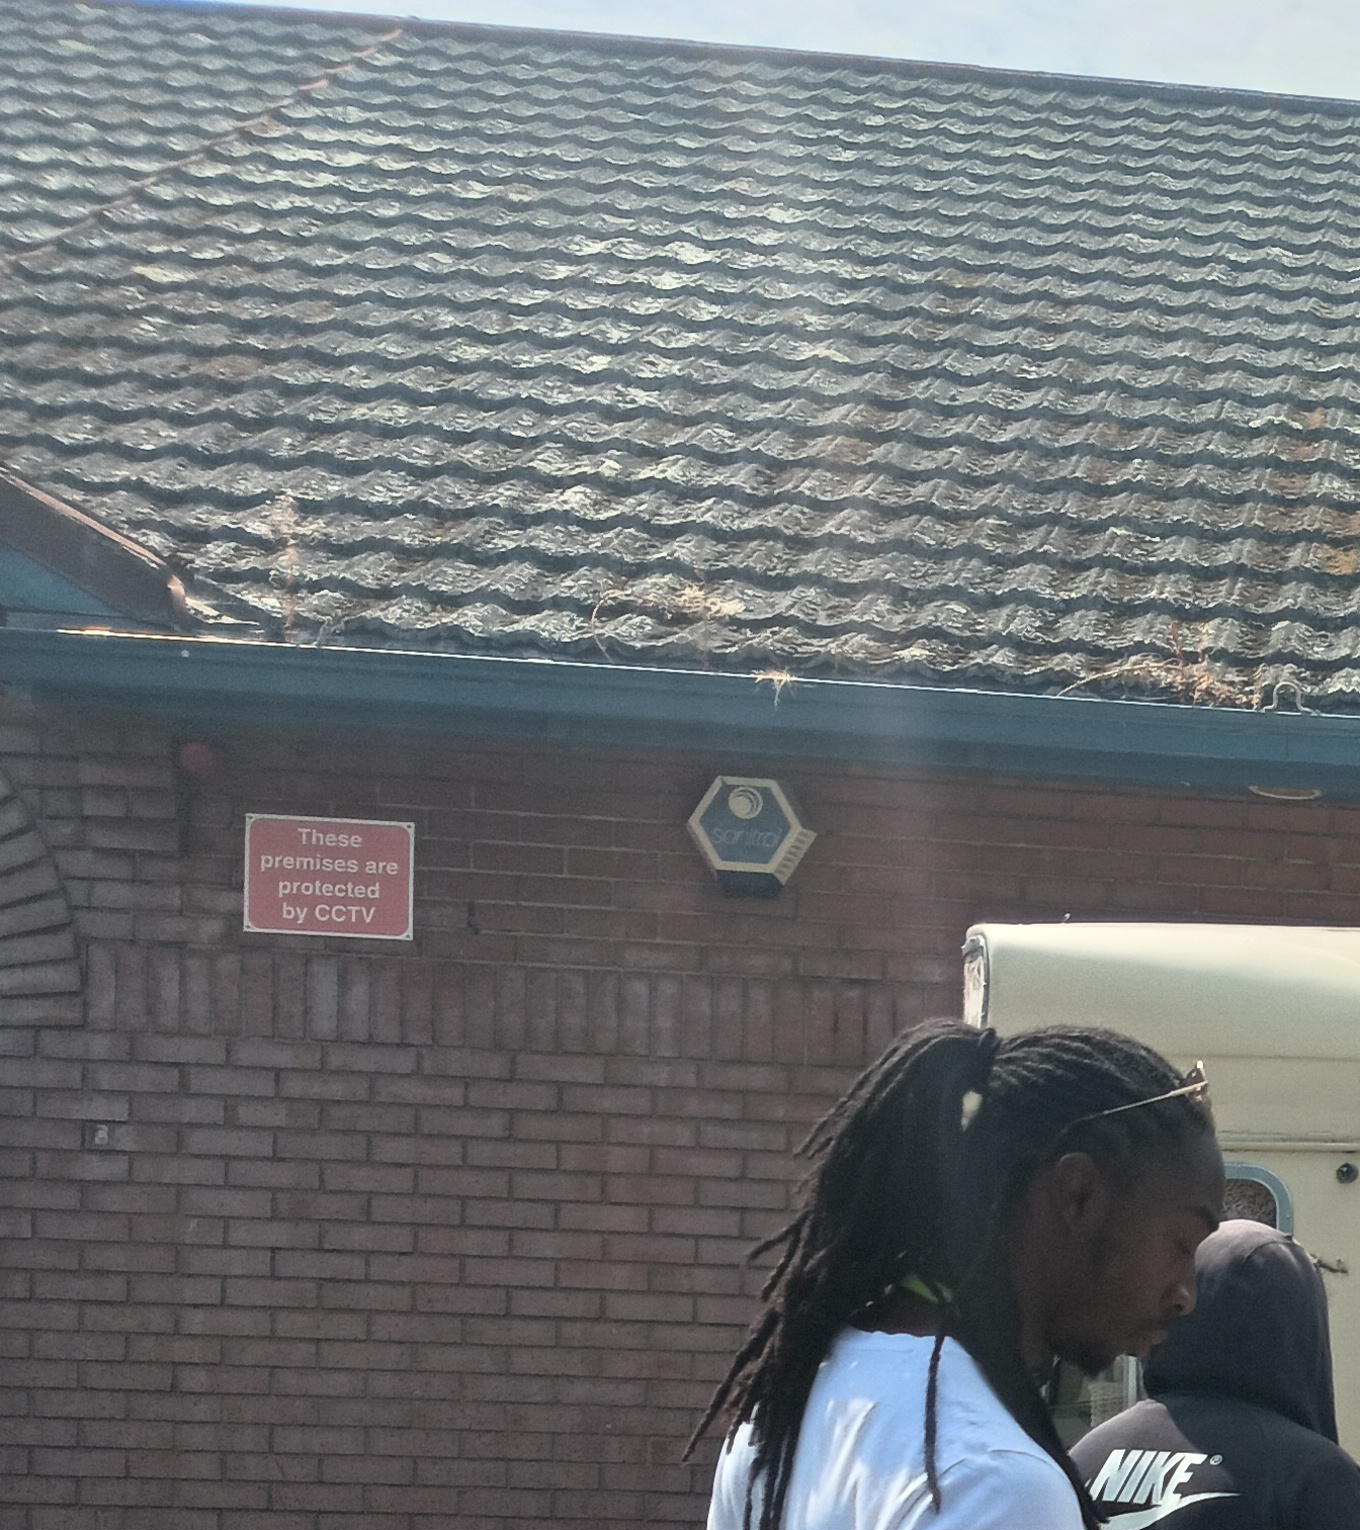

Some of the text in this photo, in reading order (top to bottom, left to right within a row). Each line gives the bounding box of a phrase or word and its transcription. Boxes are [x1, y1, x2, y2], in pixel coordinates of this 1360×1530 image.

[297, 828, 363, 848] These
[260, 854, 399, 875] premises are
[278, 880, 380, 899] protected
[282, 902, 376, 924] by CCTV
[1086, 1449, 1209, 1506] NIKE
